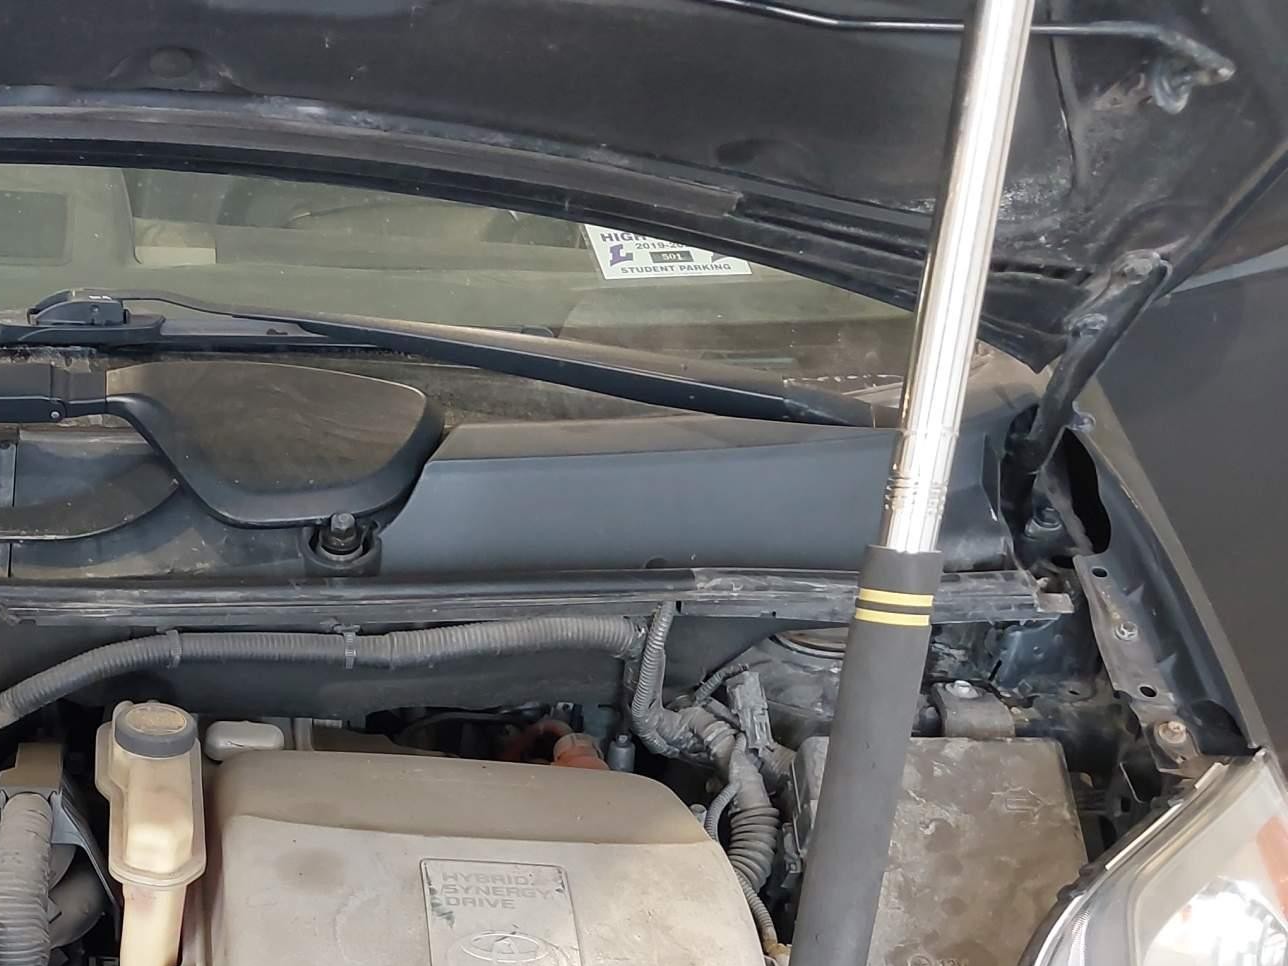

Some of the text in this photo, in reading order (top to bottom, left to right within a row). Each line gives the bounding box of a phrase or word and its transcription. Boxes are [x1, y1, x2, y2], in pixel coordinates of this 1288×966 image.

[620, 263, 732, 274] STUDENT PARKING
[442, 871, 530, 886] HYBRID
[441, 884, 552, 899] SYNERGY
[447, 897, 516, 909] DRIVE
